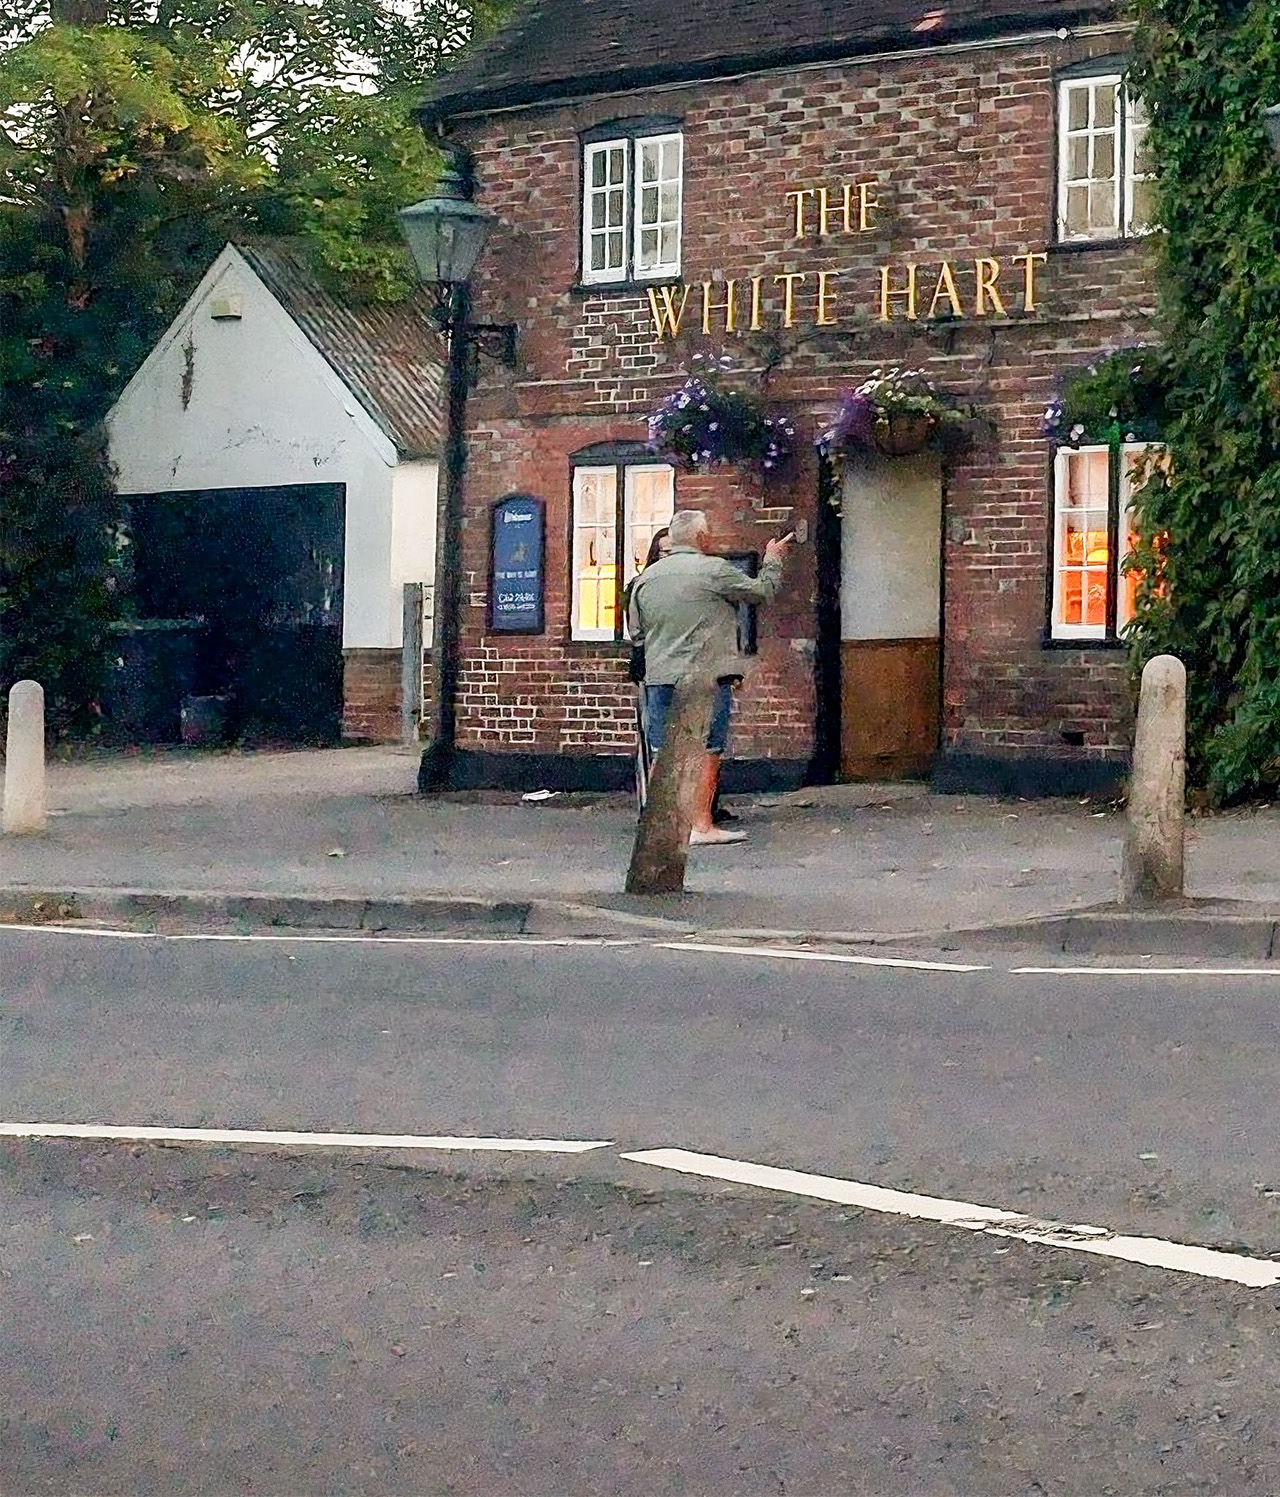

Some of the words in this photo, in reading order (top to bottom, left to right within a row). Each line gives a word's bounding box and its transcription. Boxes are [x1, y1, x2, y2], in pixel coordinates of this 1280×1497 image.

[786, 181, 880, 240] THE
[648, 270, 842, 341] WHITE
[878, 252, 1048, 322] HART
